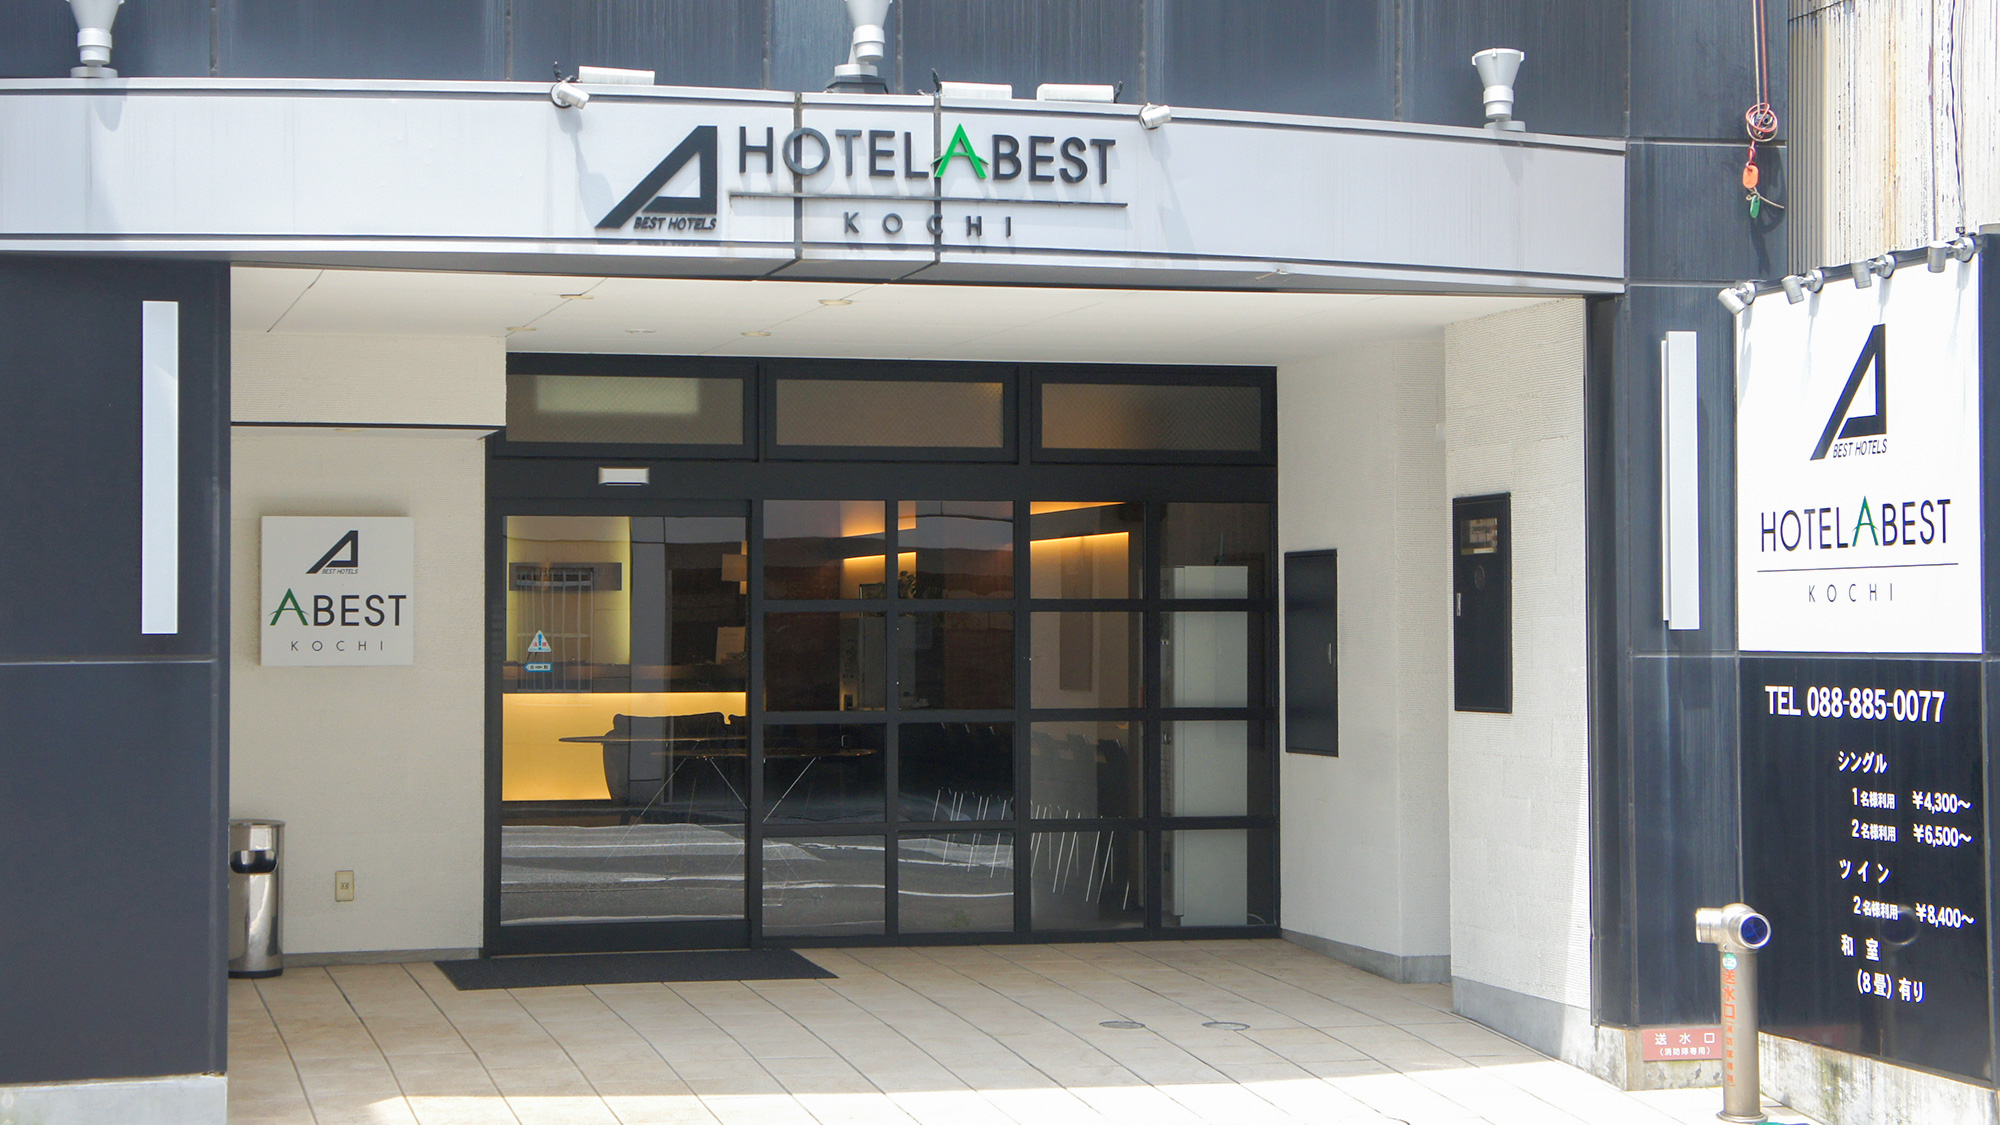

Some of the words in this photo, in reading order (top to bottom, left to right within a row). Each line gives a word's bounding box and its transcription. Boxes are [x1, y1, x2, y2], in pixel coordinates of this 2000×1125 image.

[633, 216, 666, 230] BEST
[668, 217, 717, 231] HOTELS
[844, 211, 1012, 238] KOCHI
[1832, 441, 1854, 459] BEST
[1854, 438, 1888, 456] HOTELS
[1808, 582, 1893, 603] KOCHI
[268, 587, 407, 627] ABEST
[290, 640, 383, 652] KOCHI
[1765, 685, 1802, 716] TEL
[1806, 686, 1945, 723] 088-885-0077
[1838, 751, 1888, 774] シングル
[1852, 787, 1896, 810] 1名様利用
[1851, 819, 1896, 842] 2名様利用
[1839, 859, 1890, 884] ツイン
[1853, 895, 1899, 921] 2名様利用
[1654, 1032, 1716, 1046] 送水口
